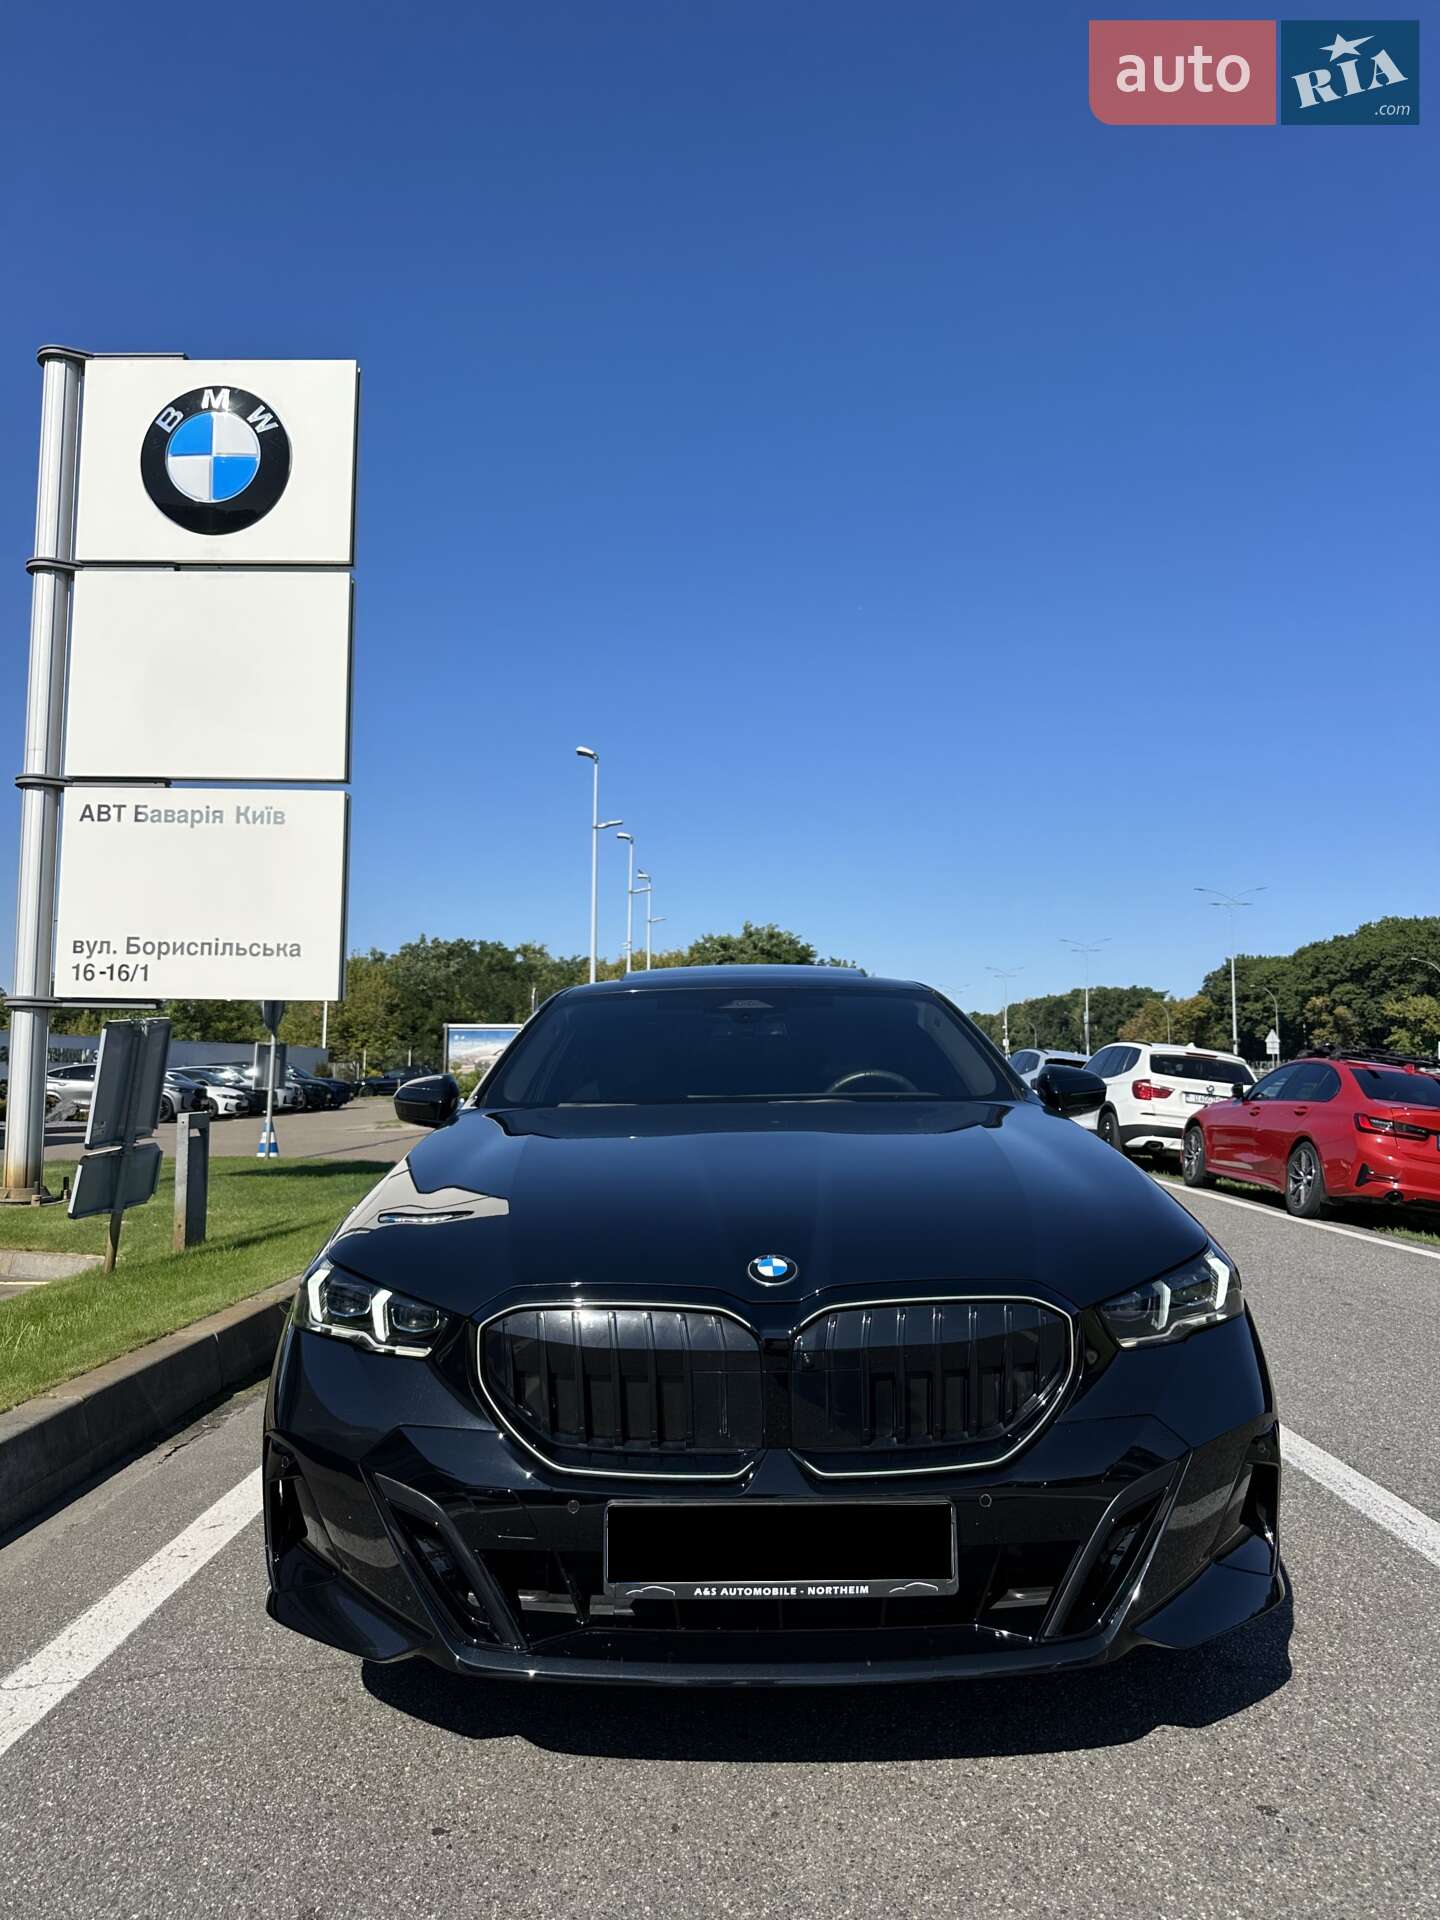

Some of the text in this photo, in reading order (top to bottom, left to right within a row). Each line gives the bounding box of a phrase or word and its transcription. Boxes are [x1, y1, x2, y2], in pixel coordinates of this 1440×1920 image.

[155, 388, 279, 433] BMW
[79, 804, 286, 828] АВТ Баварія Київ
[72, 936, 301, 960] вул. Бориспільська
[694, 1587, 717, 1596] A&S
[720, 1586, 797, 1596] AUTOMOBILE
[807, 1585, 869, 1595] NORTHEIM
